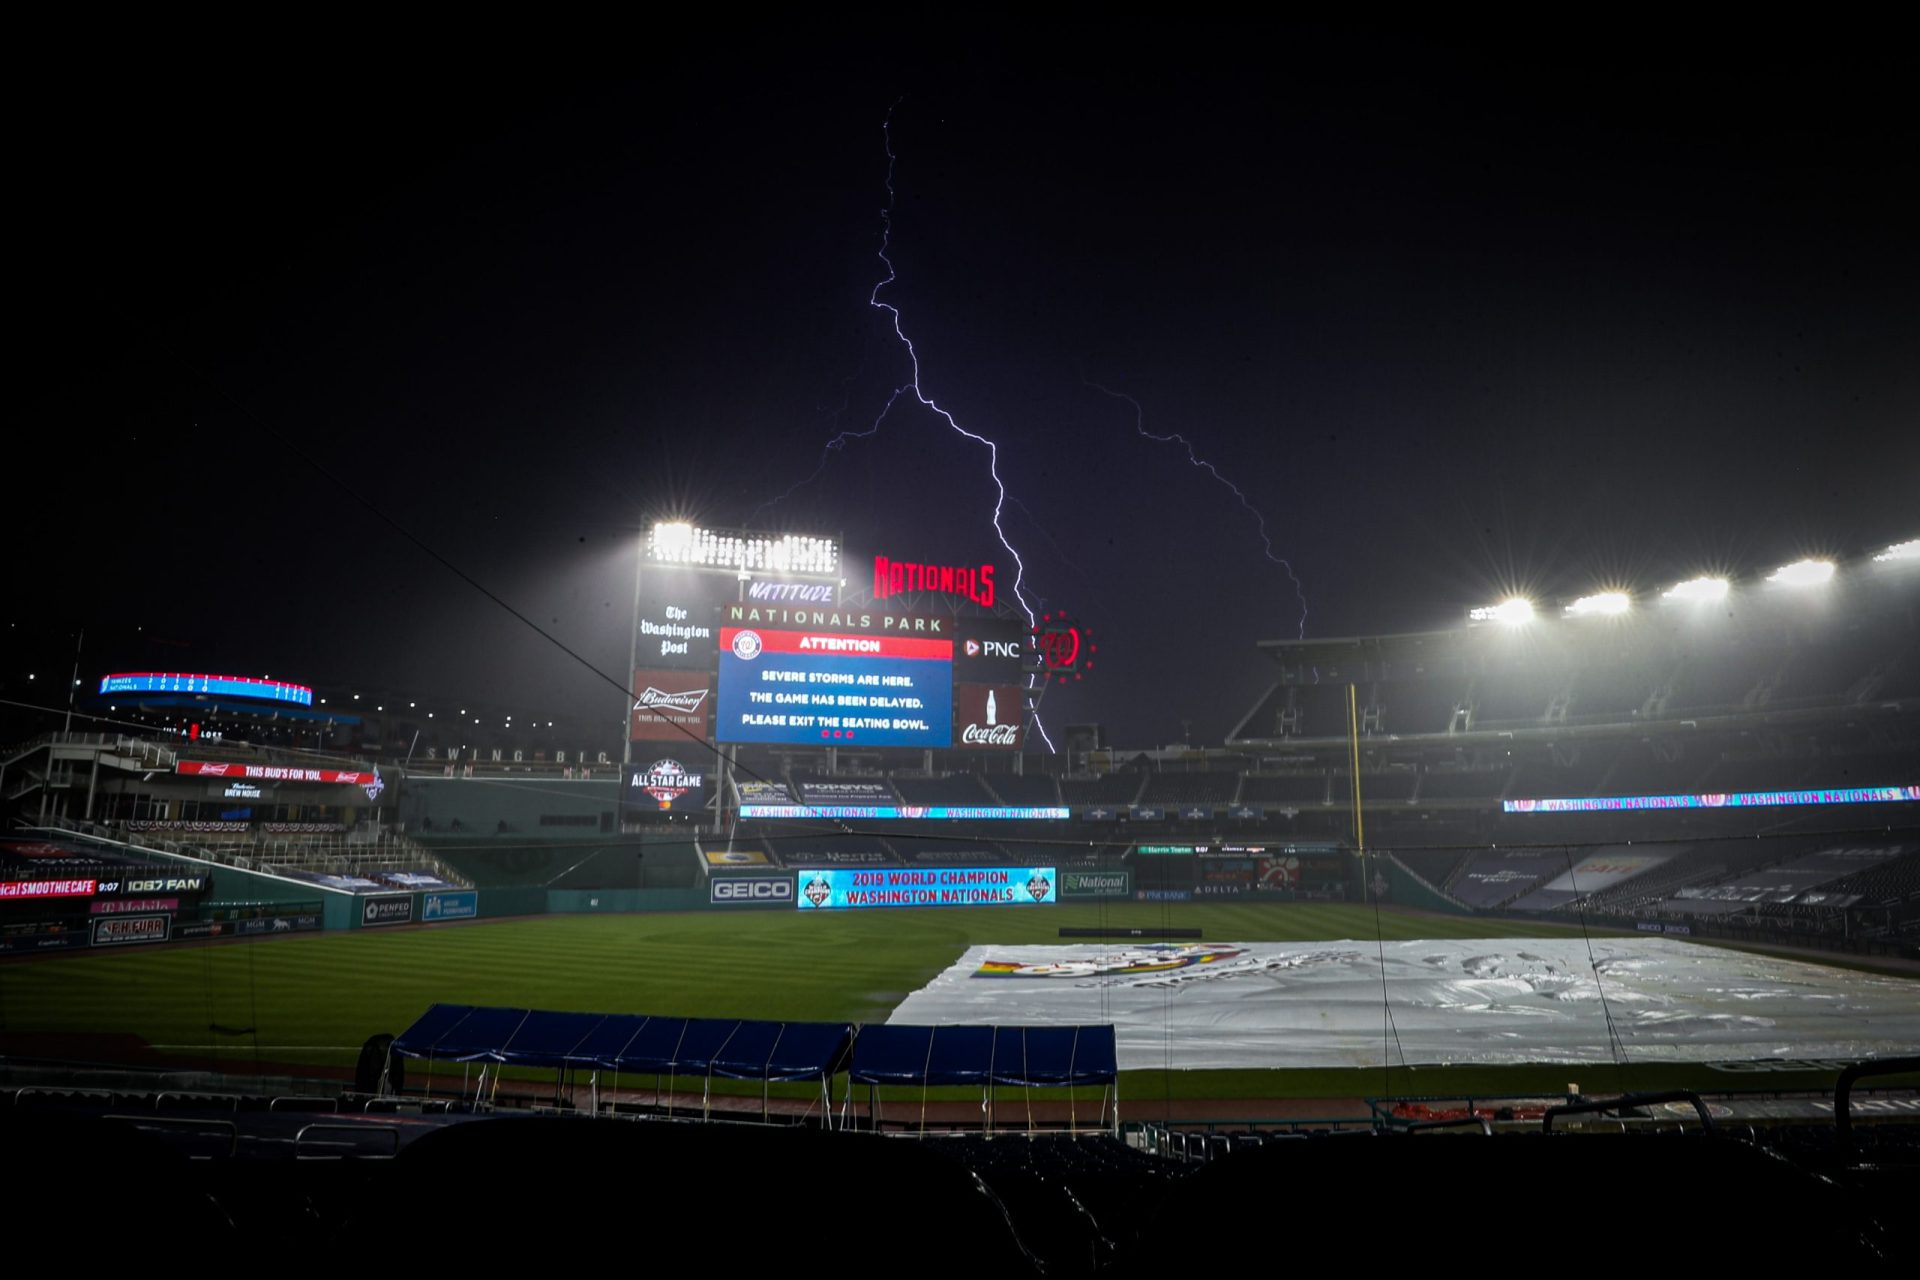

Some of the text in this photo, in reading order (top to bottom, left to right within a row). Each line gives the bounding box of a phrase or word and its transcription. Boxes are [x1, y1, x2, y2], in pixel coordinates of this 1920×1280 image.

[874, 556, 995, 607] NATIONALS
[749, 581, 833, 602] NATITUDE
[666, 606, 687, 621] The
[731, 607, 942, 632] NATIONALS PARK
[641, 619, 710, 640] Washington
[660, 640, 688, 656] Post
[800, 637, 880, 652] ATTENTION
[983, 641, 1020, 658] PNC
[762, 670, 914, 687] SEVERE STORMS ARE HERE.
[643, 690, 700, 708] Budweiser
[750, 692, 924, 709] THE GAME HAS BEEN DELAYED.
[742, 714, 929, 730] PLEASE EXIT THE SEATING BOWL.
[962, 723, 1020, 745] Coca-Cola
[427, 747, 607, 764] SWING BIG
[245, 766, 264, 778] THIS
[264, 766, 288, 779] BUD'S
[289, 768, 304, 780] FOR
[305, 769, 322, 781] YOU.
[632, 774, 702, 788] ALL STAR GAME
[224, 788, 261, 799] BREW HOUSE
[1740, 789, 1893, 805] WASHINGTON NATIONALS
[1549, 796, 1689, 811] WASHINGTON NATIONALS
[751, 806, 877, 817] WASHINGTON NATIONALS
[946, 807, 1061, 818] WASHINGTON NATIONALS
[166, 878, 200, 891] FAN
[853, 871, 1008, 886] 2019 WORLD CHAMPION
[1079, 876, 1124, 888] National
[21, 880, 70, 895] SMOOTHIE
[70, 880, 93, 893] CAFE
[98, 882, 119, 893] 9:07
[714, 882, 790, 898] GEICO
[1205, 886, 1239, 894] DELTA
[846, 889, 937, 905] WASHINGTON
[941, 888, 1013, 903] NATIONALS
[379, 902, 410, 913] PENFED
[246, 920, 265, 930] MGM
